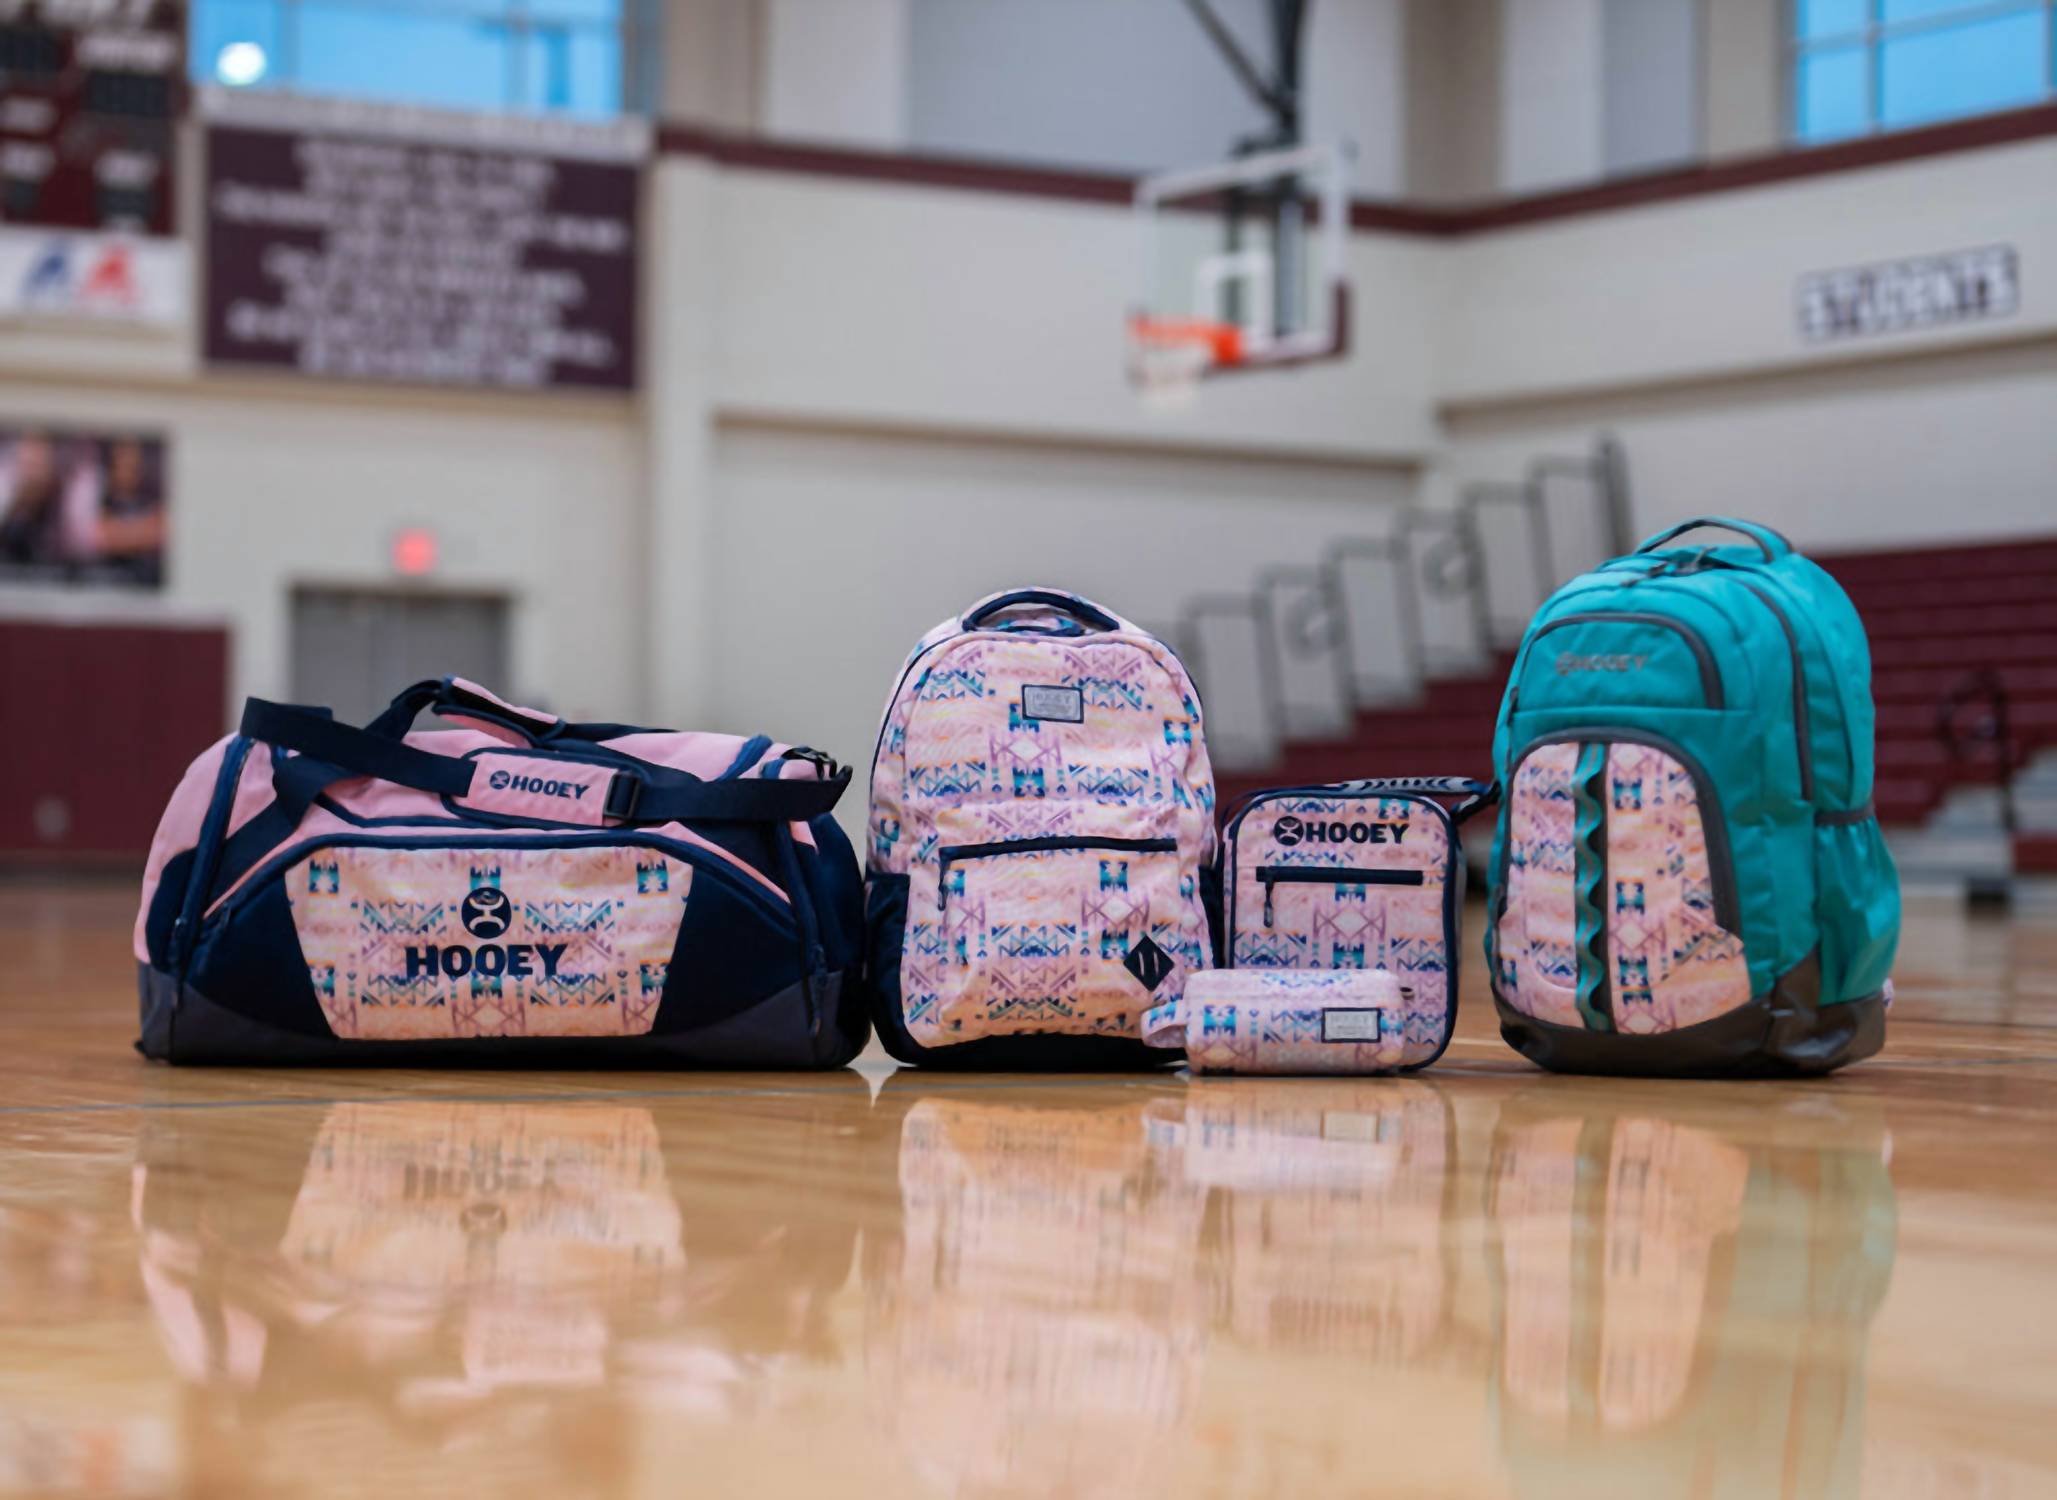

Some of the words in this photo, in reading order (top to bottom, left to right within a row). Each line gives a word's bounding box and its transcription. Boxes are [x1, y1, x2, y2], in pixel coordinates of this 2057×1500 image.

[510, 775, 590, 800] HOOEY
[1305, 821, 1410, 844] HOOEY
[405, 944, 568, 978] HOOEY
